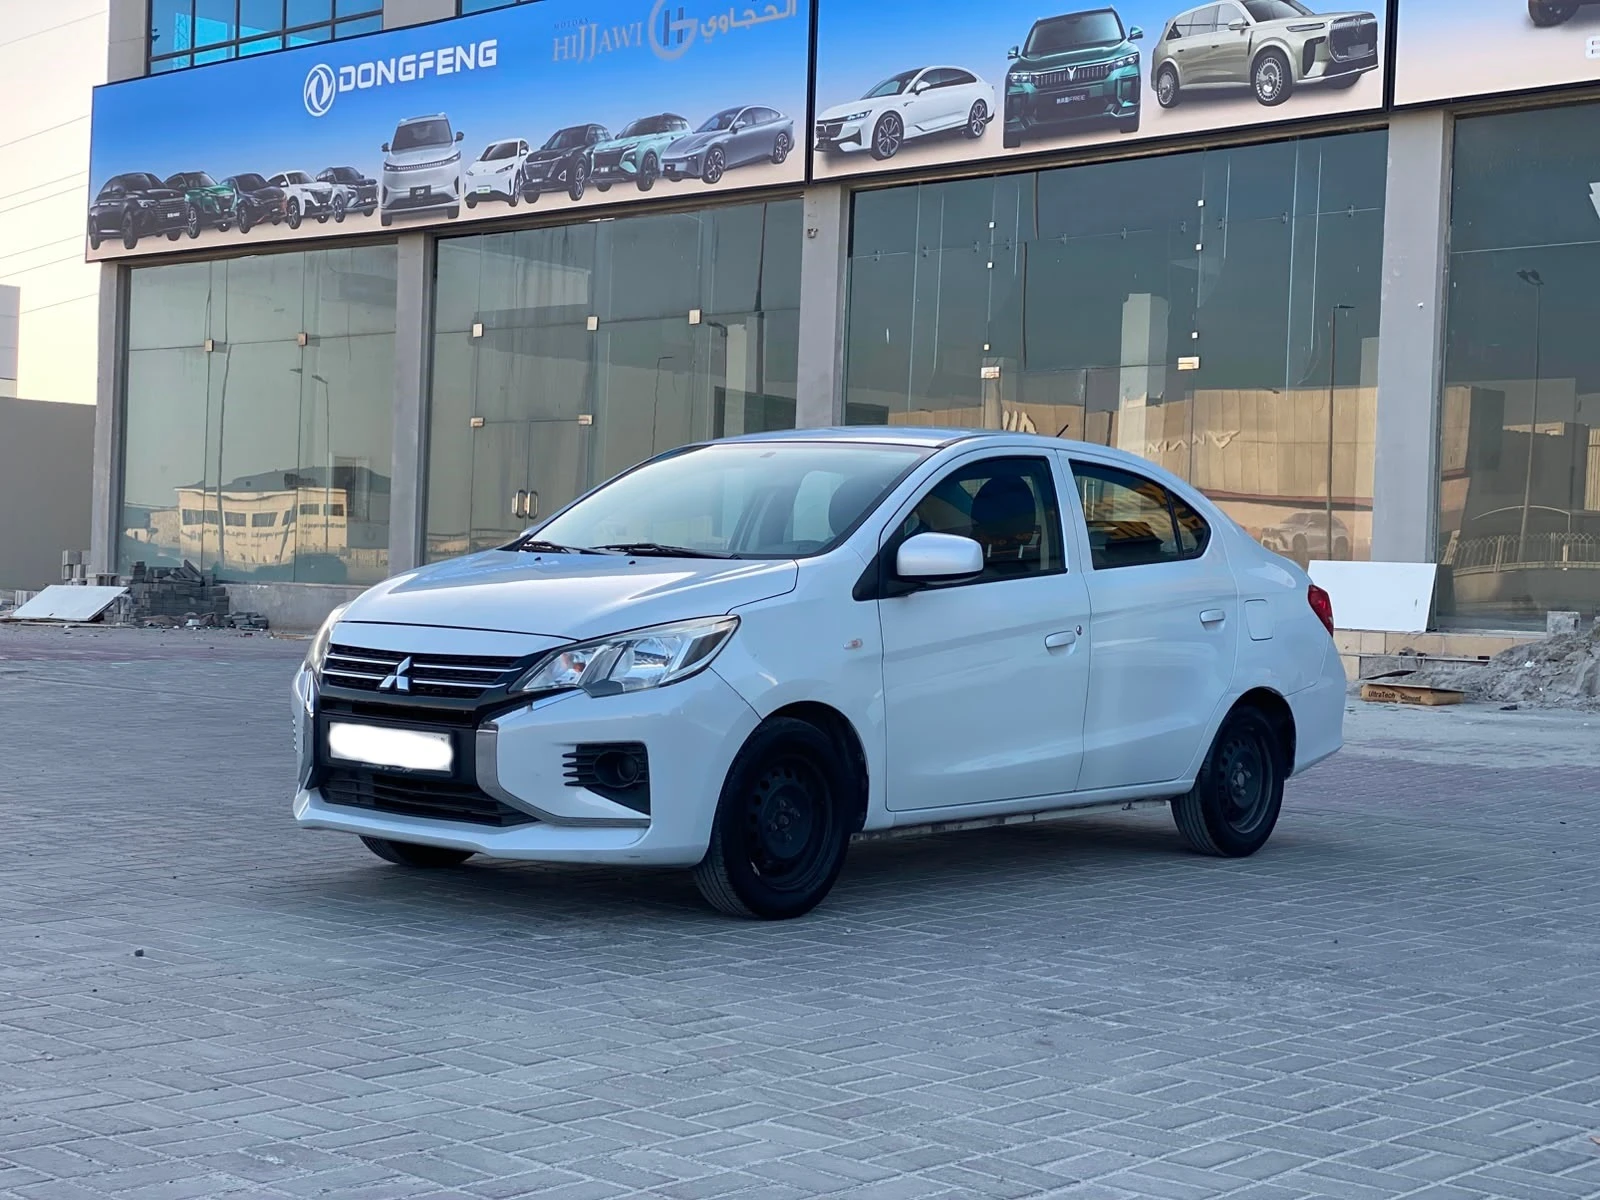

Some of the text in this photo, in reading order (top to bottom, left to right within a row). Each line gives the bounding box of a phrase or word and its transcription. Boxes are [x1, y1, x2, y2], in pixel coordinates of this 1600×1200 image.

[554, 17, 589, 30] MOTORS
[701, 0, 796, 43] الحجاوي
[552, 22, 643, 64] HIJJAWI
[338, 39, 497, 92] DONGFENG
[1368, 690, 1396, 699] UltraTech
